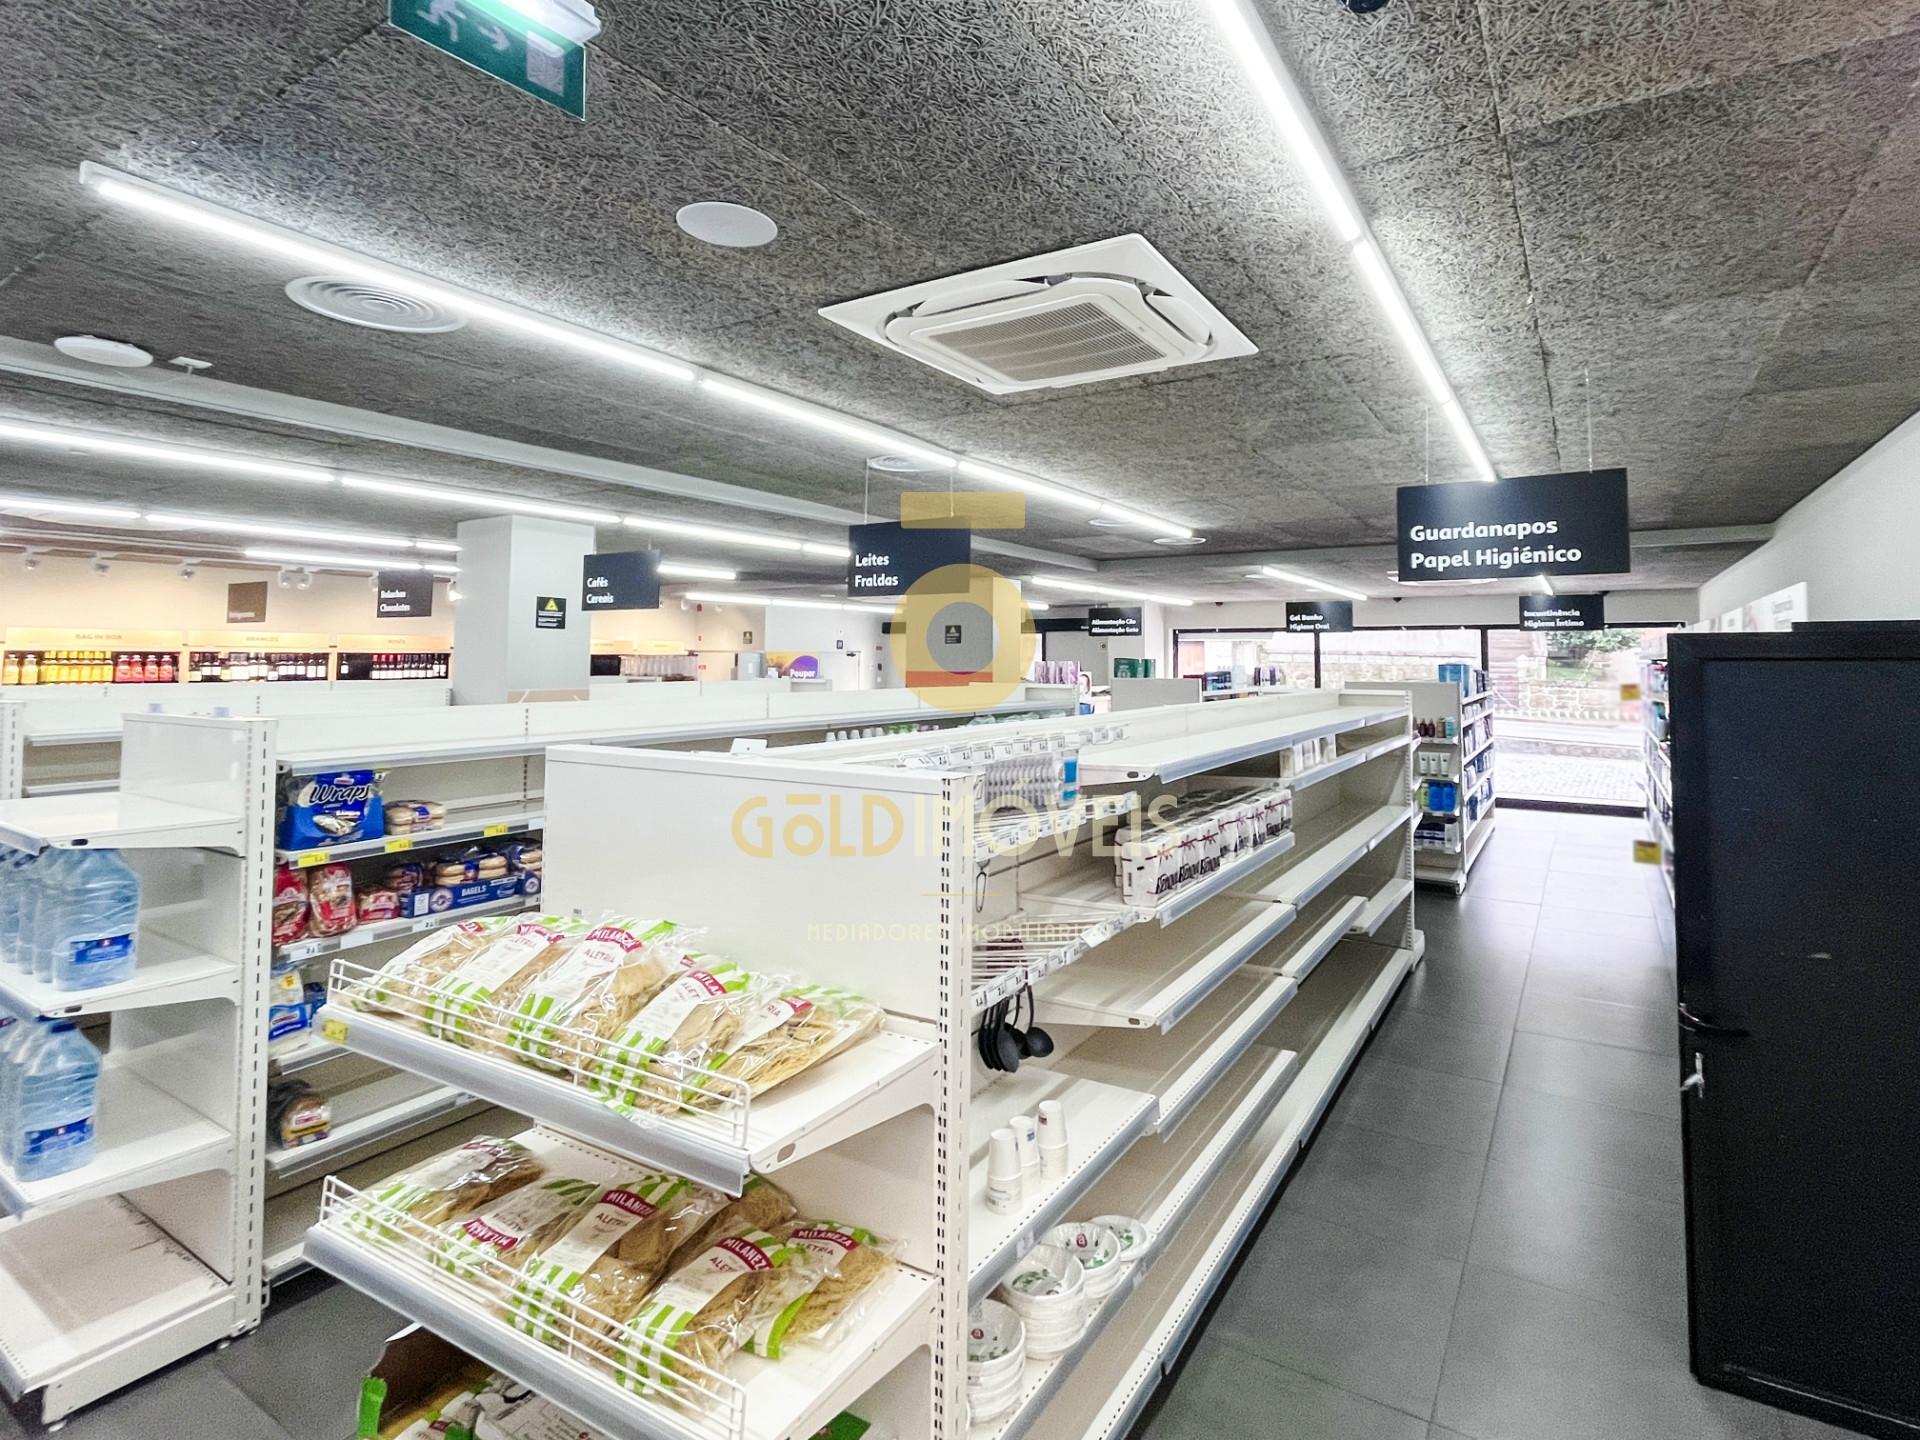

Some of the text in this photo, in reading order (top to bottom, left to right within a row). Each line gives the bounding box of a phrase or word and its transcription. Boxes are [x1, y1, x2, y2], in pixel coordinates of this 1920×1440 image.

[1410, 520, 1558, 542] Guardanapos
[855, 552, 890, 568] Leites
[1411, 545, 1582, 572] Papel Higiénico
[854, 573, 899, 588] Fraldas
[309, 784, 372, 805] Wraps
[461, 884, 488, 897] BAGELS
[798, 1230, 853, 1247] MILANEZA
